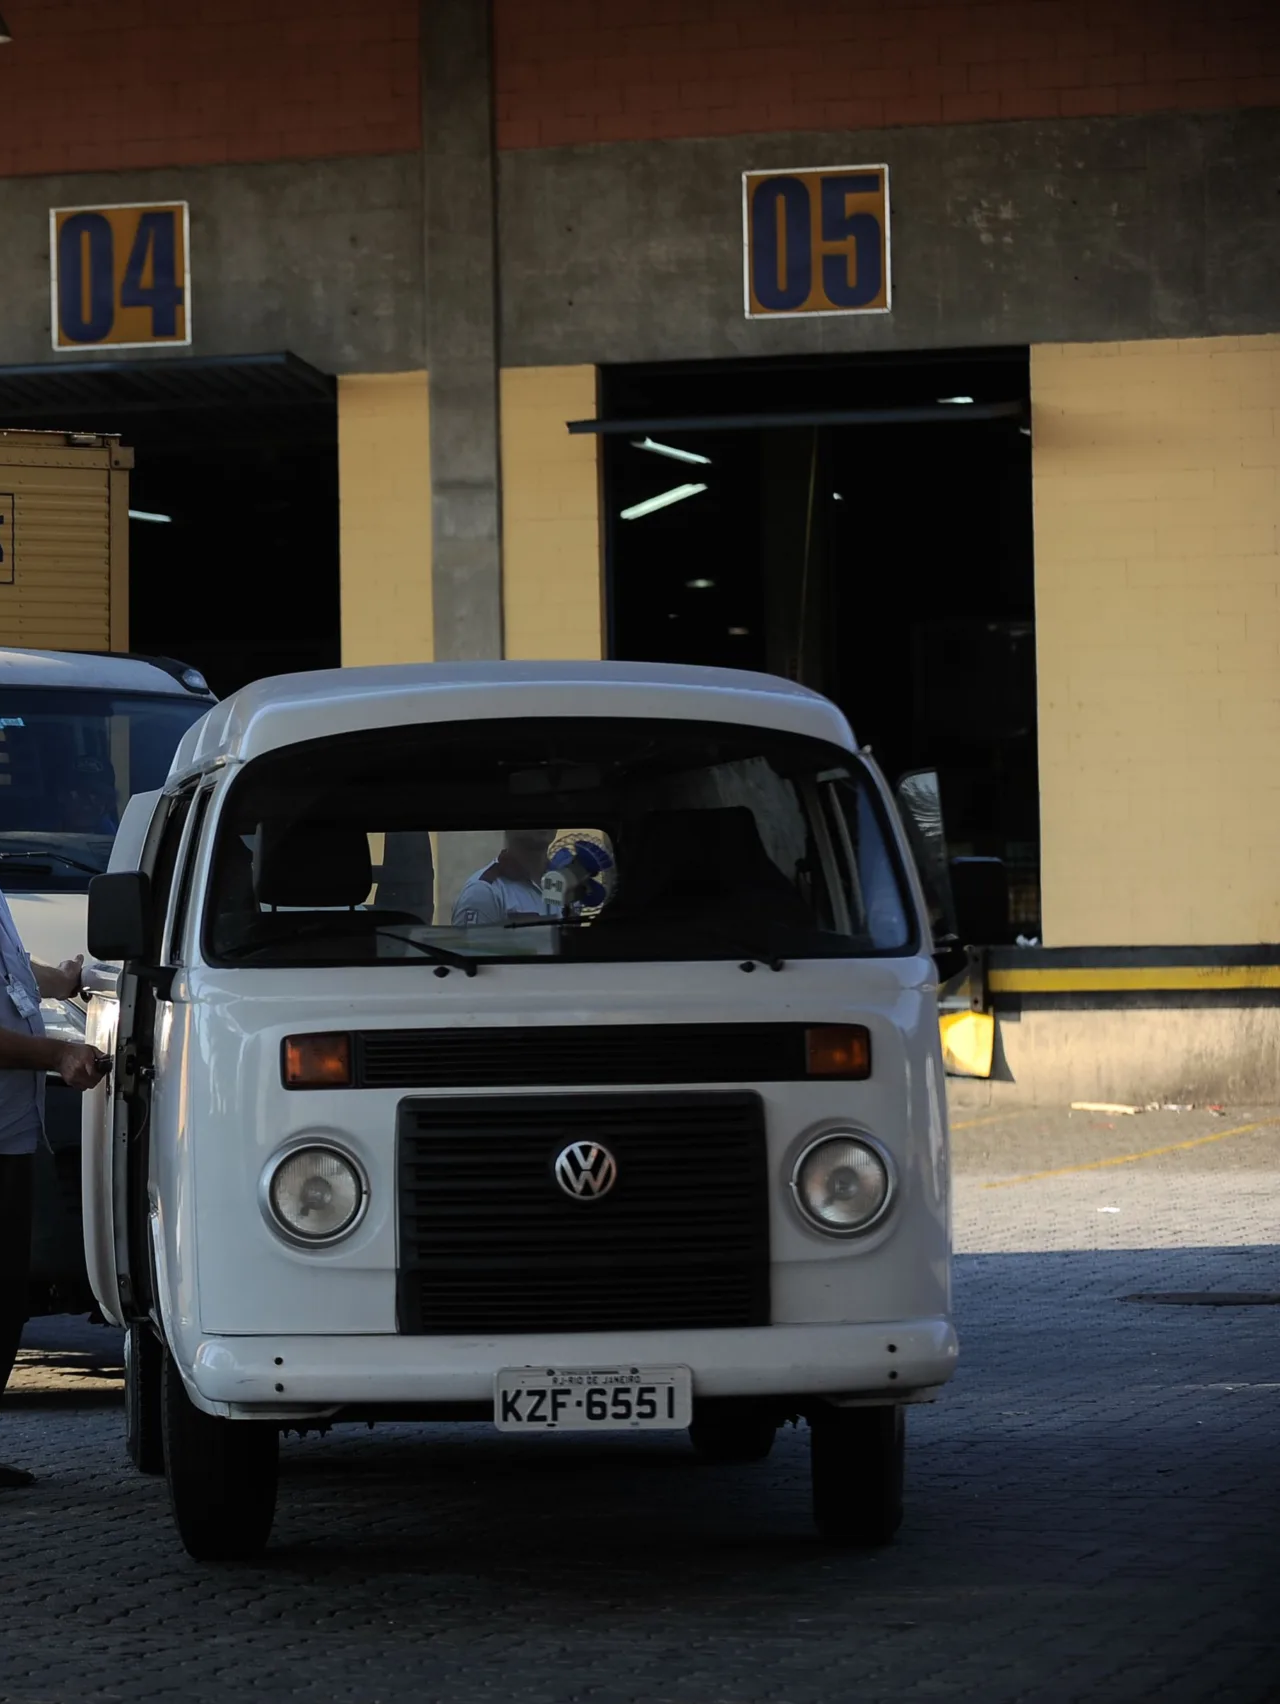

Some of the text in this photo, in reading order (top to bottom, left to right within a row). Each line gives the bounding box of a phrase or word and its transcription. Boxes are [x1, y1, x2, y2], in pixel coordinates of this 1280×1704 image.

[60, 212, 184, 343] 04
[753, 174, 881, 310] 05
[586, 1375, 599, 1385] DE
[602, 1375, 642, 1385] JANEIRO
